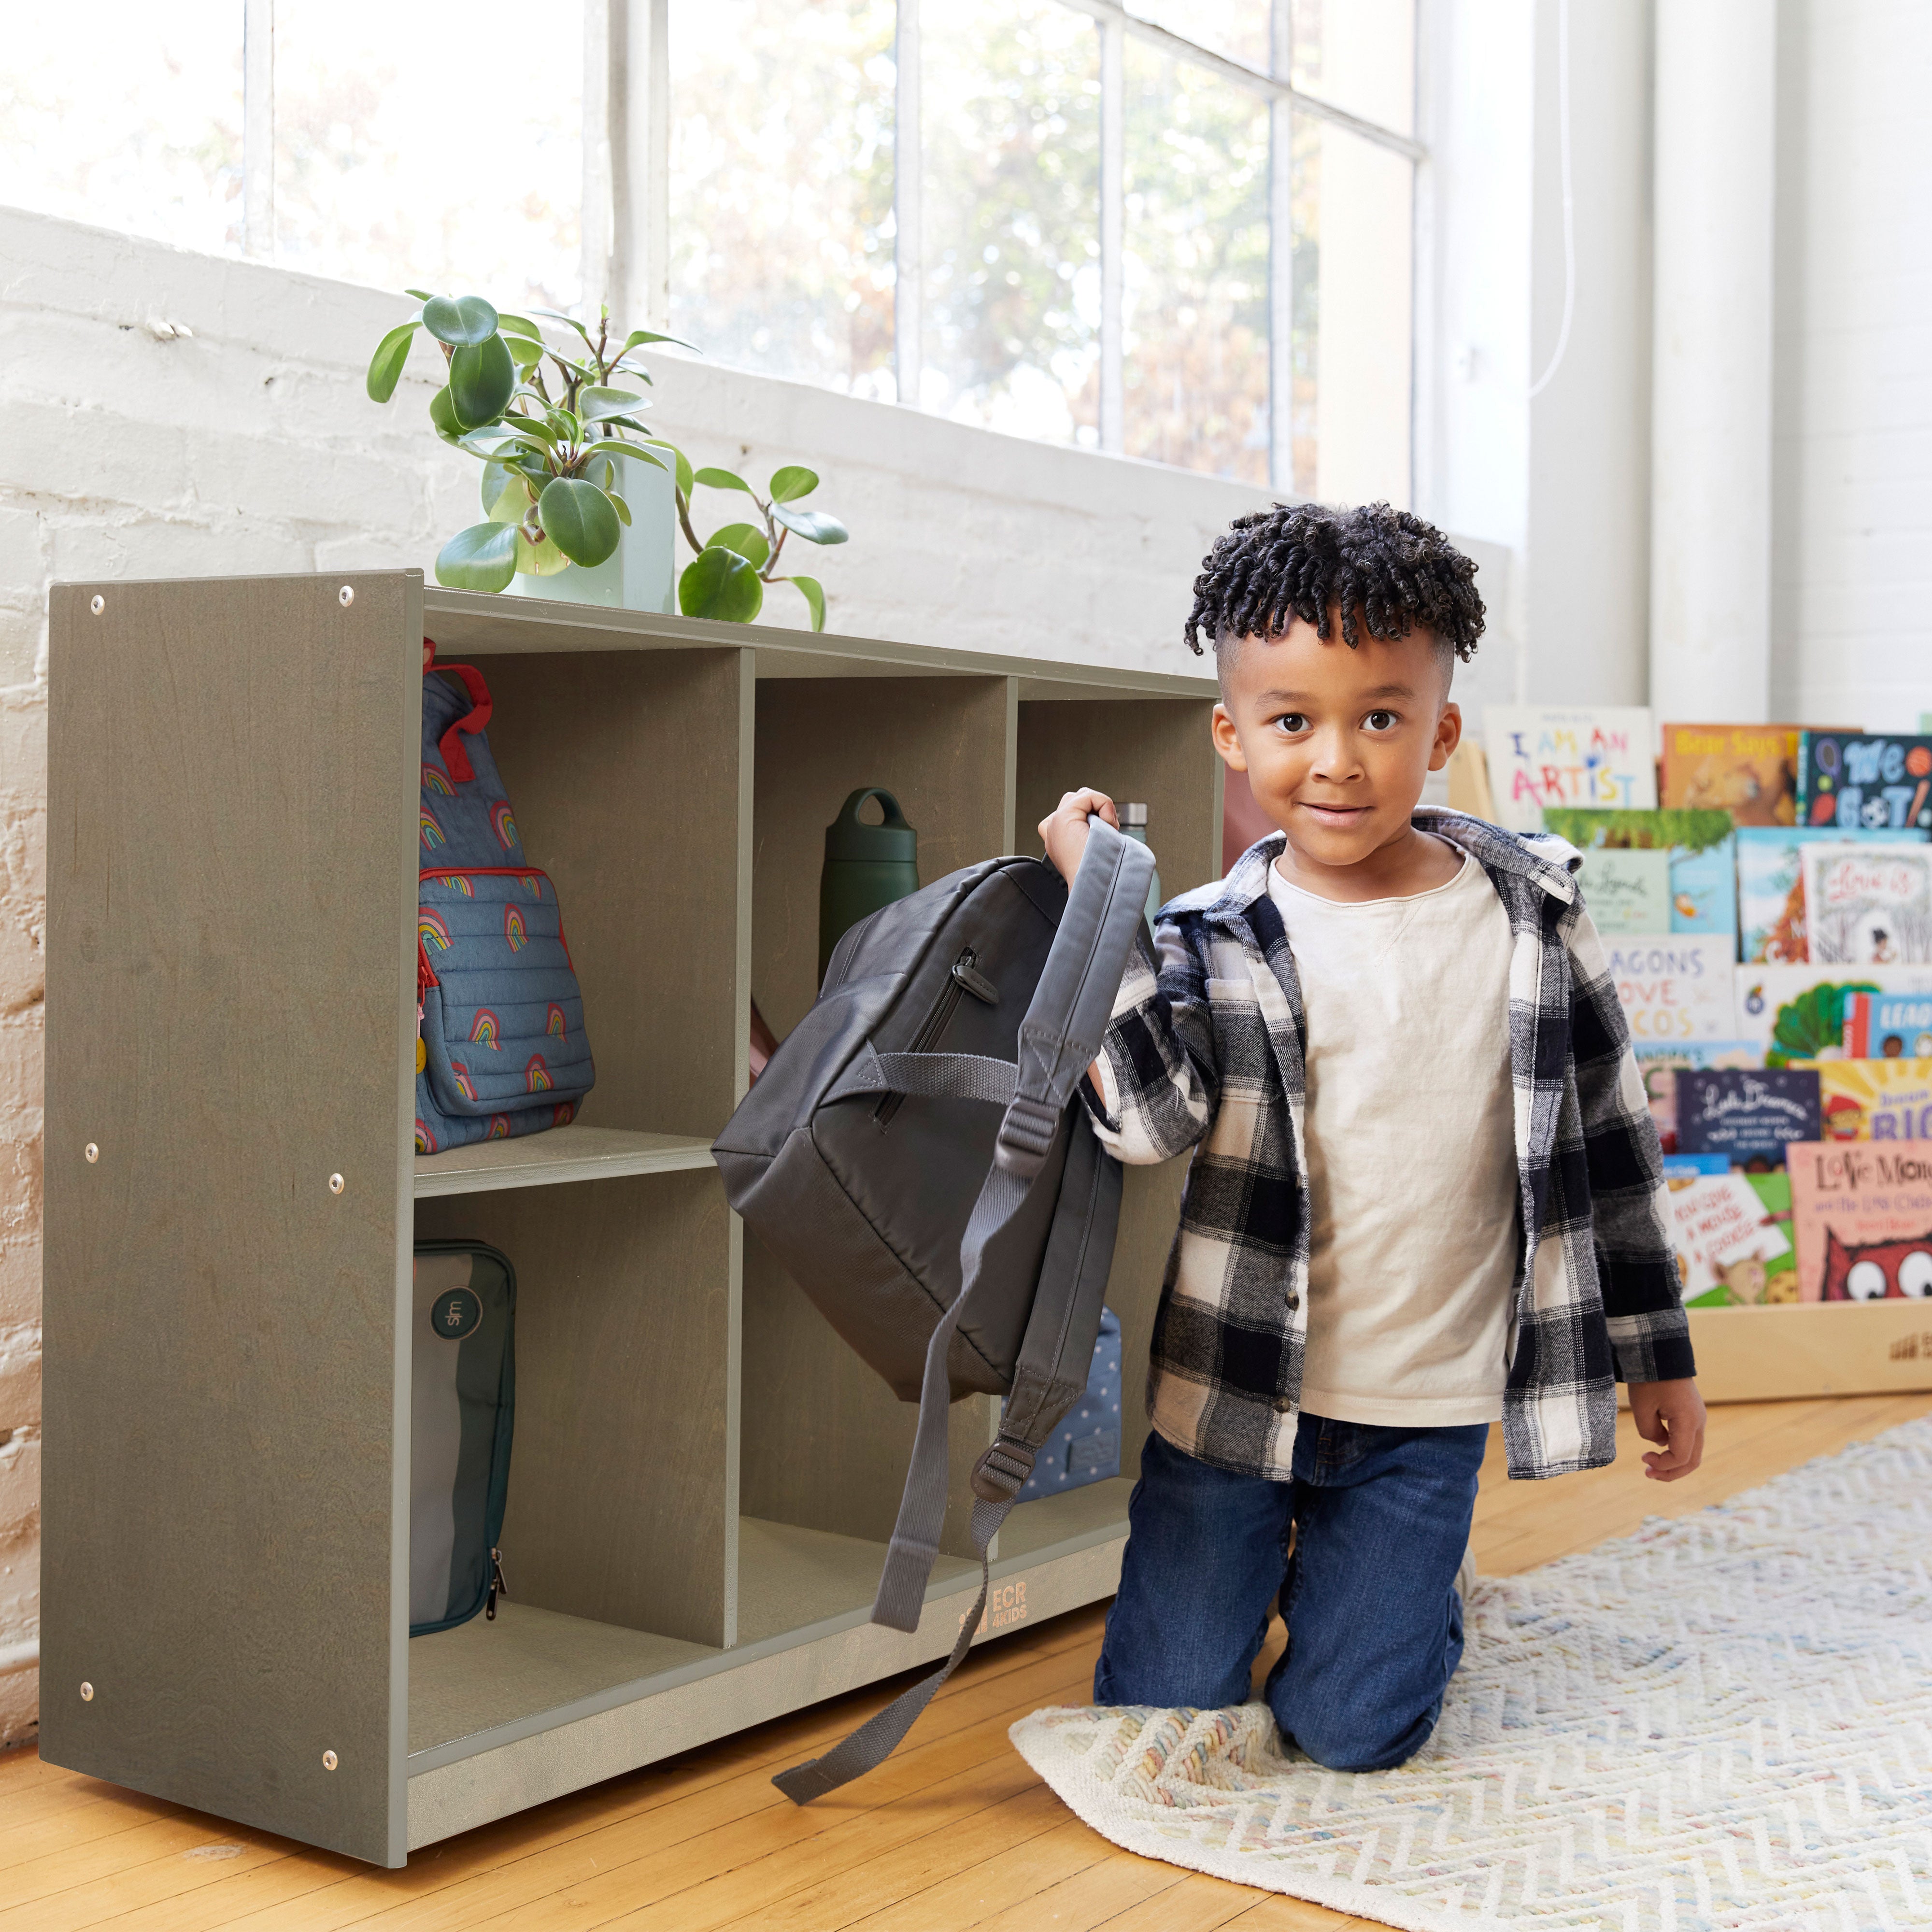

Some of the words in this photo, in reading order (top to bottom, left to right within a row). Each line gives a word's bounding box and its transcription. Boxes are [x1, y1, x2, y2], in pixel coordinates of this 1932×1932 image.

[1508, 731, 1530, 758] I
[1537, 729, 1578, 754] AM
[1590, 725, 1630, 753] AN
[1676, 730, 1723, 756] Bear
[1731, 731, 1780, 763] Says
[1843, 739, 1905, 784] We
[993, 1581, 1027, 1612] ECR
[993, 1604, 1027, 1628] 4KIDS
